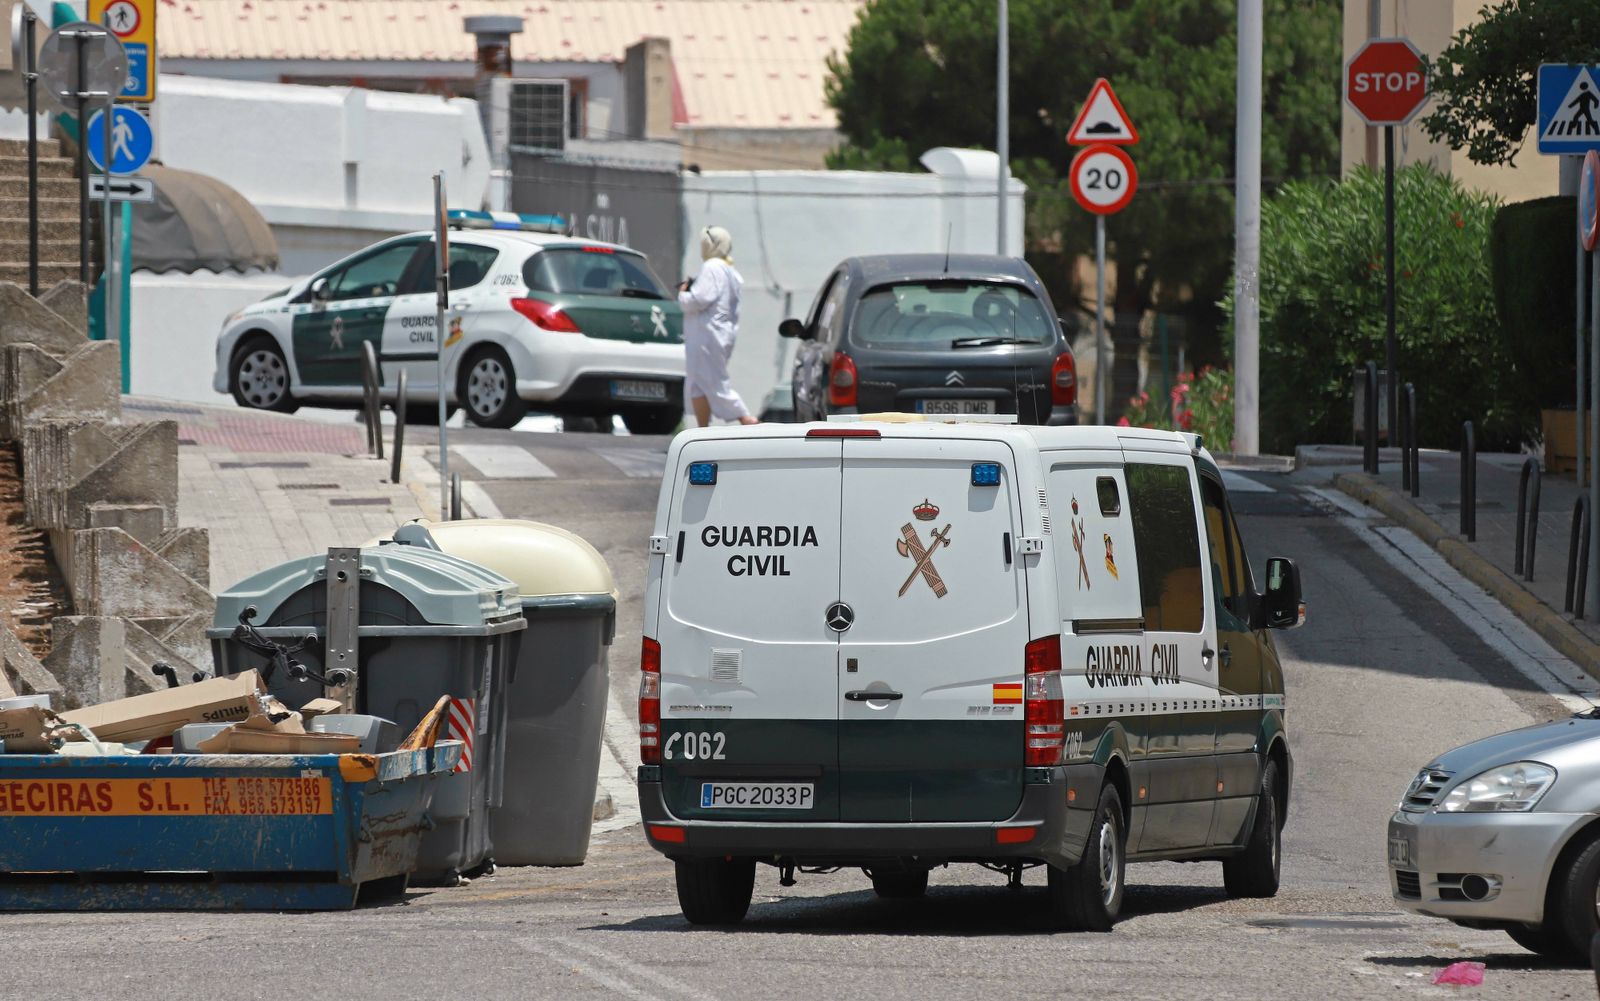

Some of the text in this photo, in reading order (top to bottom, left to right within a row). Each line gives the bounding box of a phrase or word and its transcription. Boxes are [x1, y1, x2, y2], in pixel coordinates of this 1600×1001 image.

[1354, 72, 1421, 93] STOP
[1087, 168, 1121, 190] 20
[409, 332, 434, 343] CIVIL
[926, 401, 959, 414] 8596
[701, 525, 819, 547] GUARDIA
[727, 554, 791, 576] CIVIL
[1085, 643, 1180, 688] GUARDIA CIVIL
[684, 731, 726, 760] 062
[1069, 731, 1083, 759] 062
[138, 782, 190, 812] S.L.
